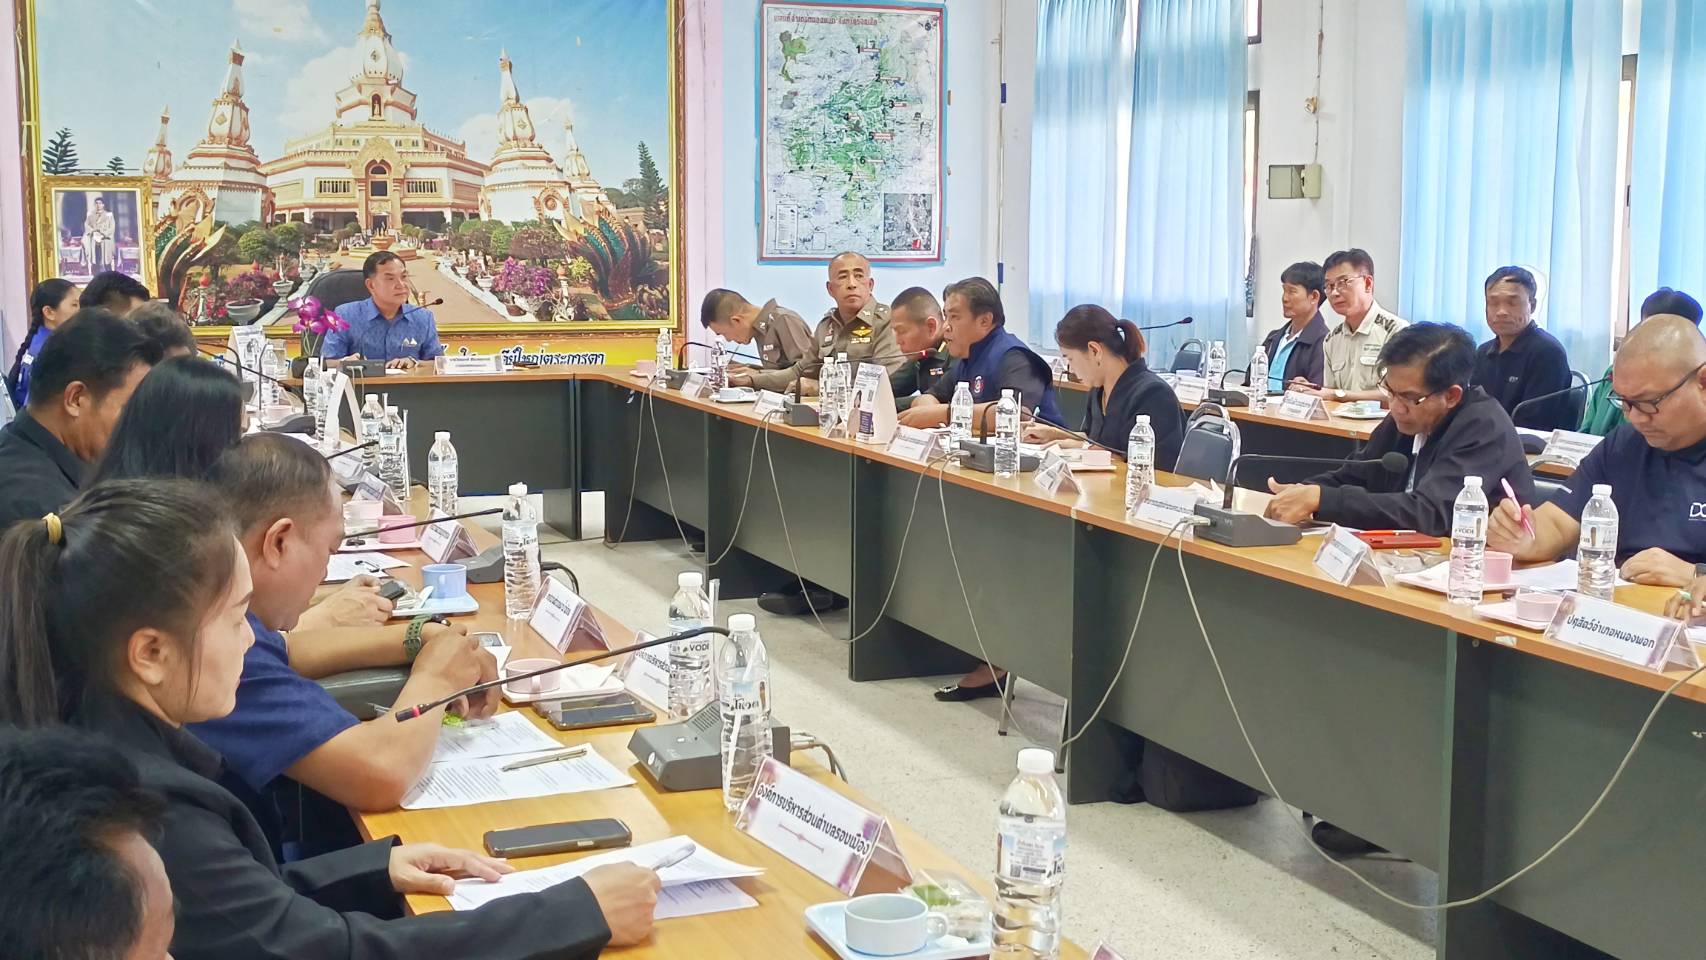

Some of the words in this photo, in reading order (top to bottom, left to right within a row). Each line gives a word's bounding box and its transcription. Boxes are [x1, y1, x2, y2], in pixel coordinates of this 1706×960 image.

[856, 44, 861, 54] 1
[875, 73, 881, 82] 2
[888, 100, 895, 109] 3
[868, 131, 875, 141] 5
[860, 155, 867, 165] 6
[848, 172, 854, 182] 7
[1566, 615, 1655, 649] ปศุสัตว์อำเภอหนองพอก
[757, 784, 870, 855] องค์การบริหารส่วนตำบลรอบเมือง
